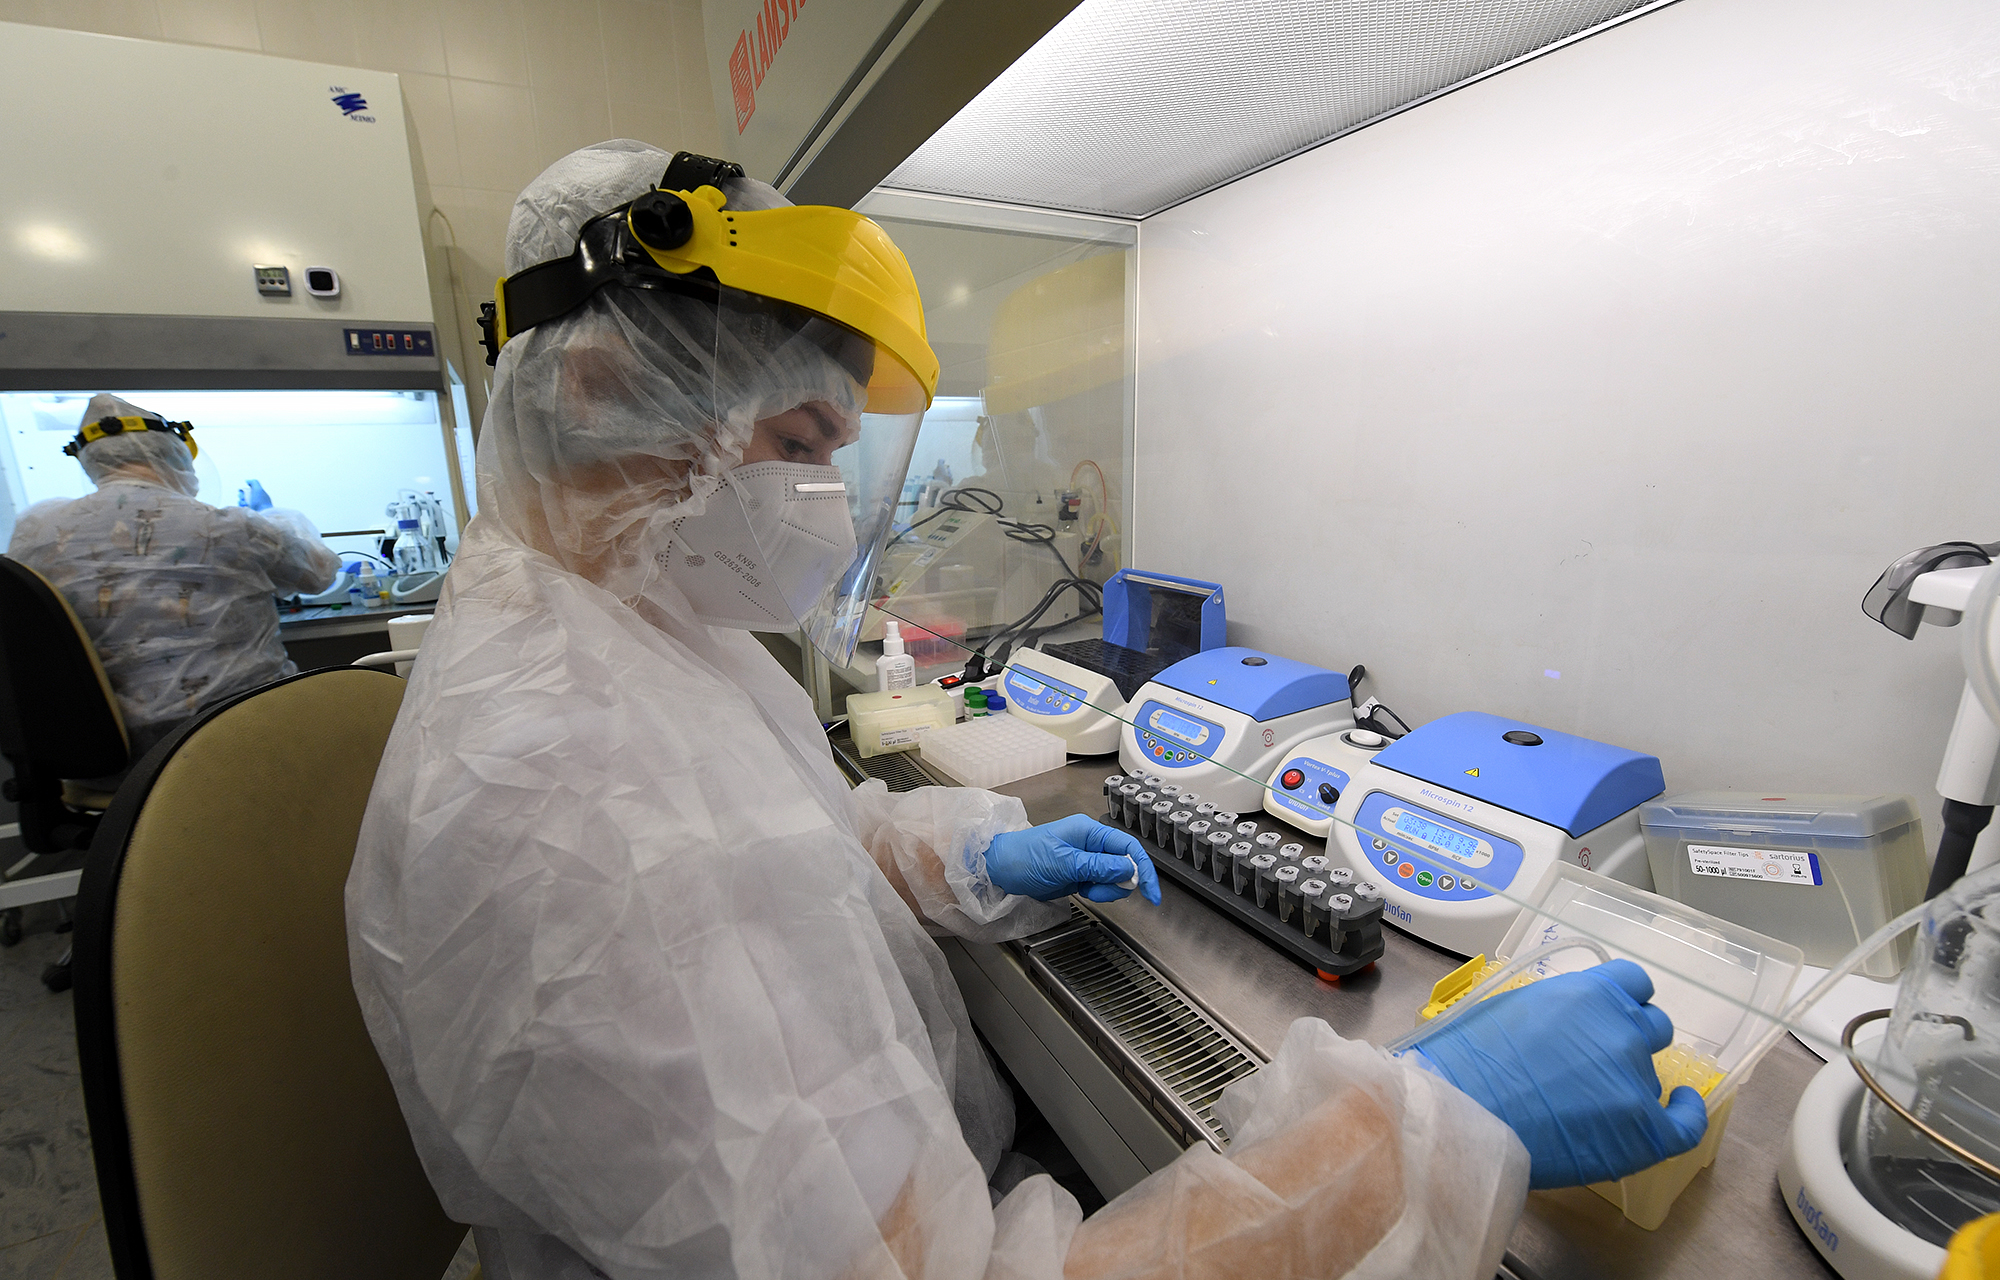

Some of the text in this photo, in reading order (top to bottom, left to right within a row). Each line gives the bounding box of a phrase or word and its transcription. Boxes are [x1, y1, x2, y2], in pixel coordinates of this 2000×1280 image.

[736, 553, 757, 570] KN95
[714, 550, 761, 588] GB2626-2006
[1303, 760, 1321, 771] Vortex
[1419, 788, 1474, 812] Microspin 12
[1316, 801, 1331, 811] Speed
[1403, 824, 1420, 835] RUN
[1431, 836, 1451, 848] 13.0
[1428, 844, 1440, 852] RPM
[1769, 853, 1806, 862] sartorius
[1695, 865, 1720, 874] 50-1000
[1418, 874, 1432, 883] Open
